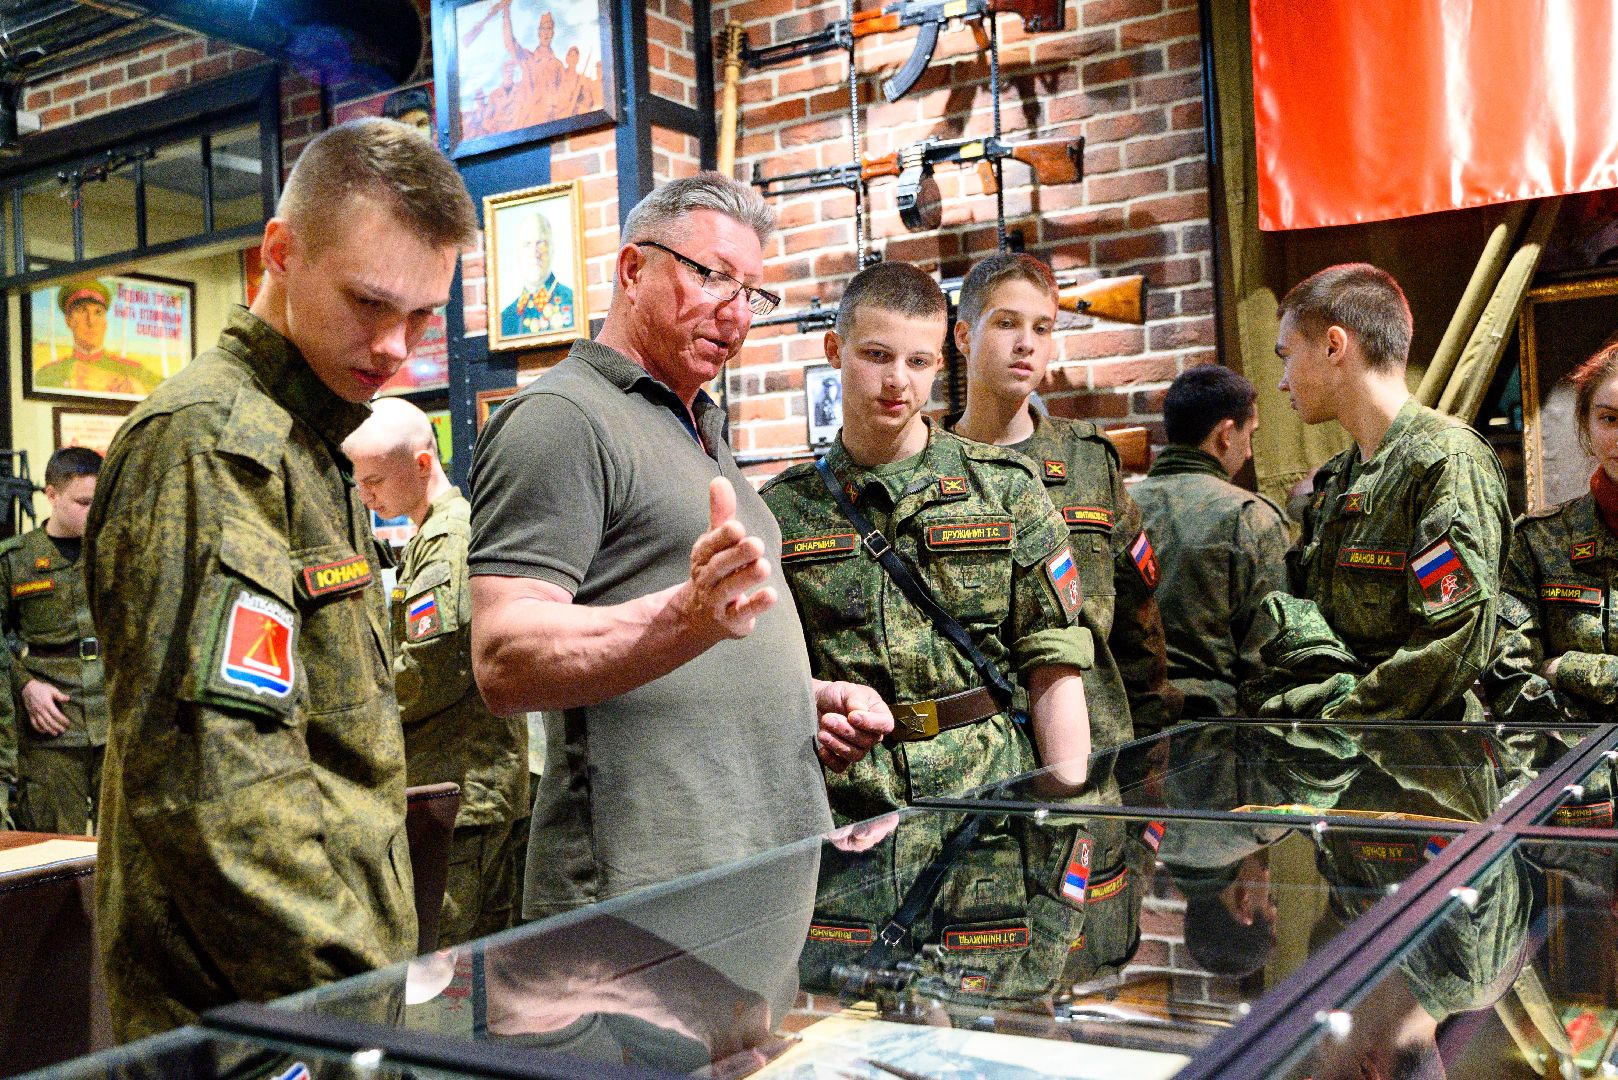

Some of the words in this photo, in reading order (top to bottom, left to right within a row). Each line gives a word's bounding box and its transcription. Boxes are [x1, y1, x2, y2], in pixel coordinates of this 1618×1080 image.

[942, 529, 984, 541] ДРУЖИНИН
[986, 527, 1000, 537] Т.С.
[794, 539, 836, 551] ЮНАРМИЯ
[1350, 552, 1375, 564] ИВАНОВ
[1377, 555, 1392, 565] И.А.
